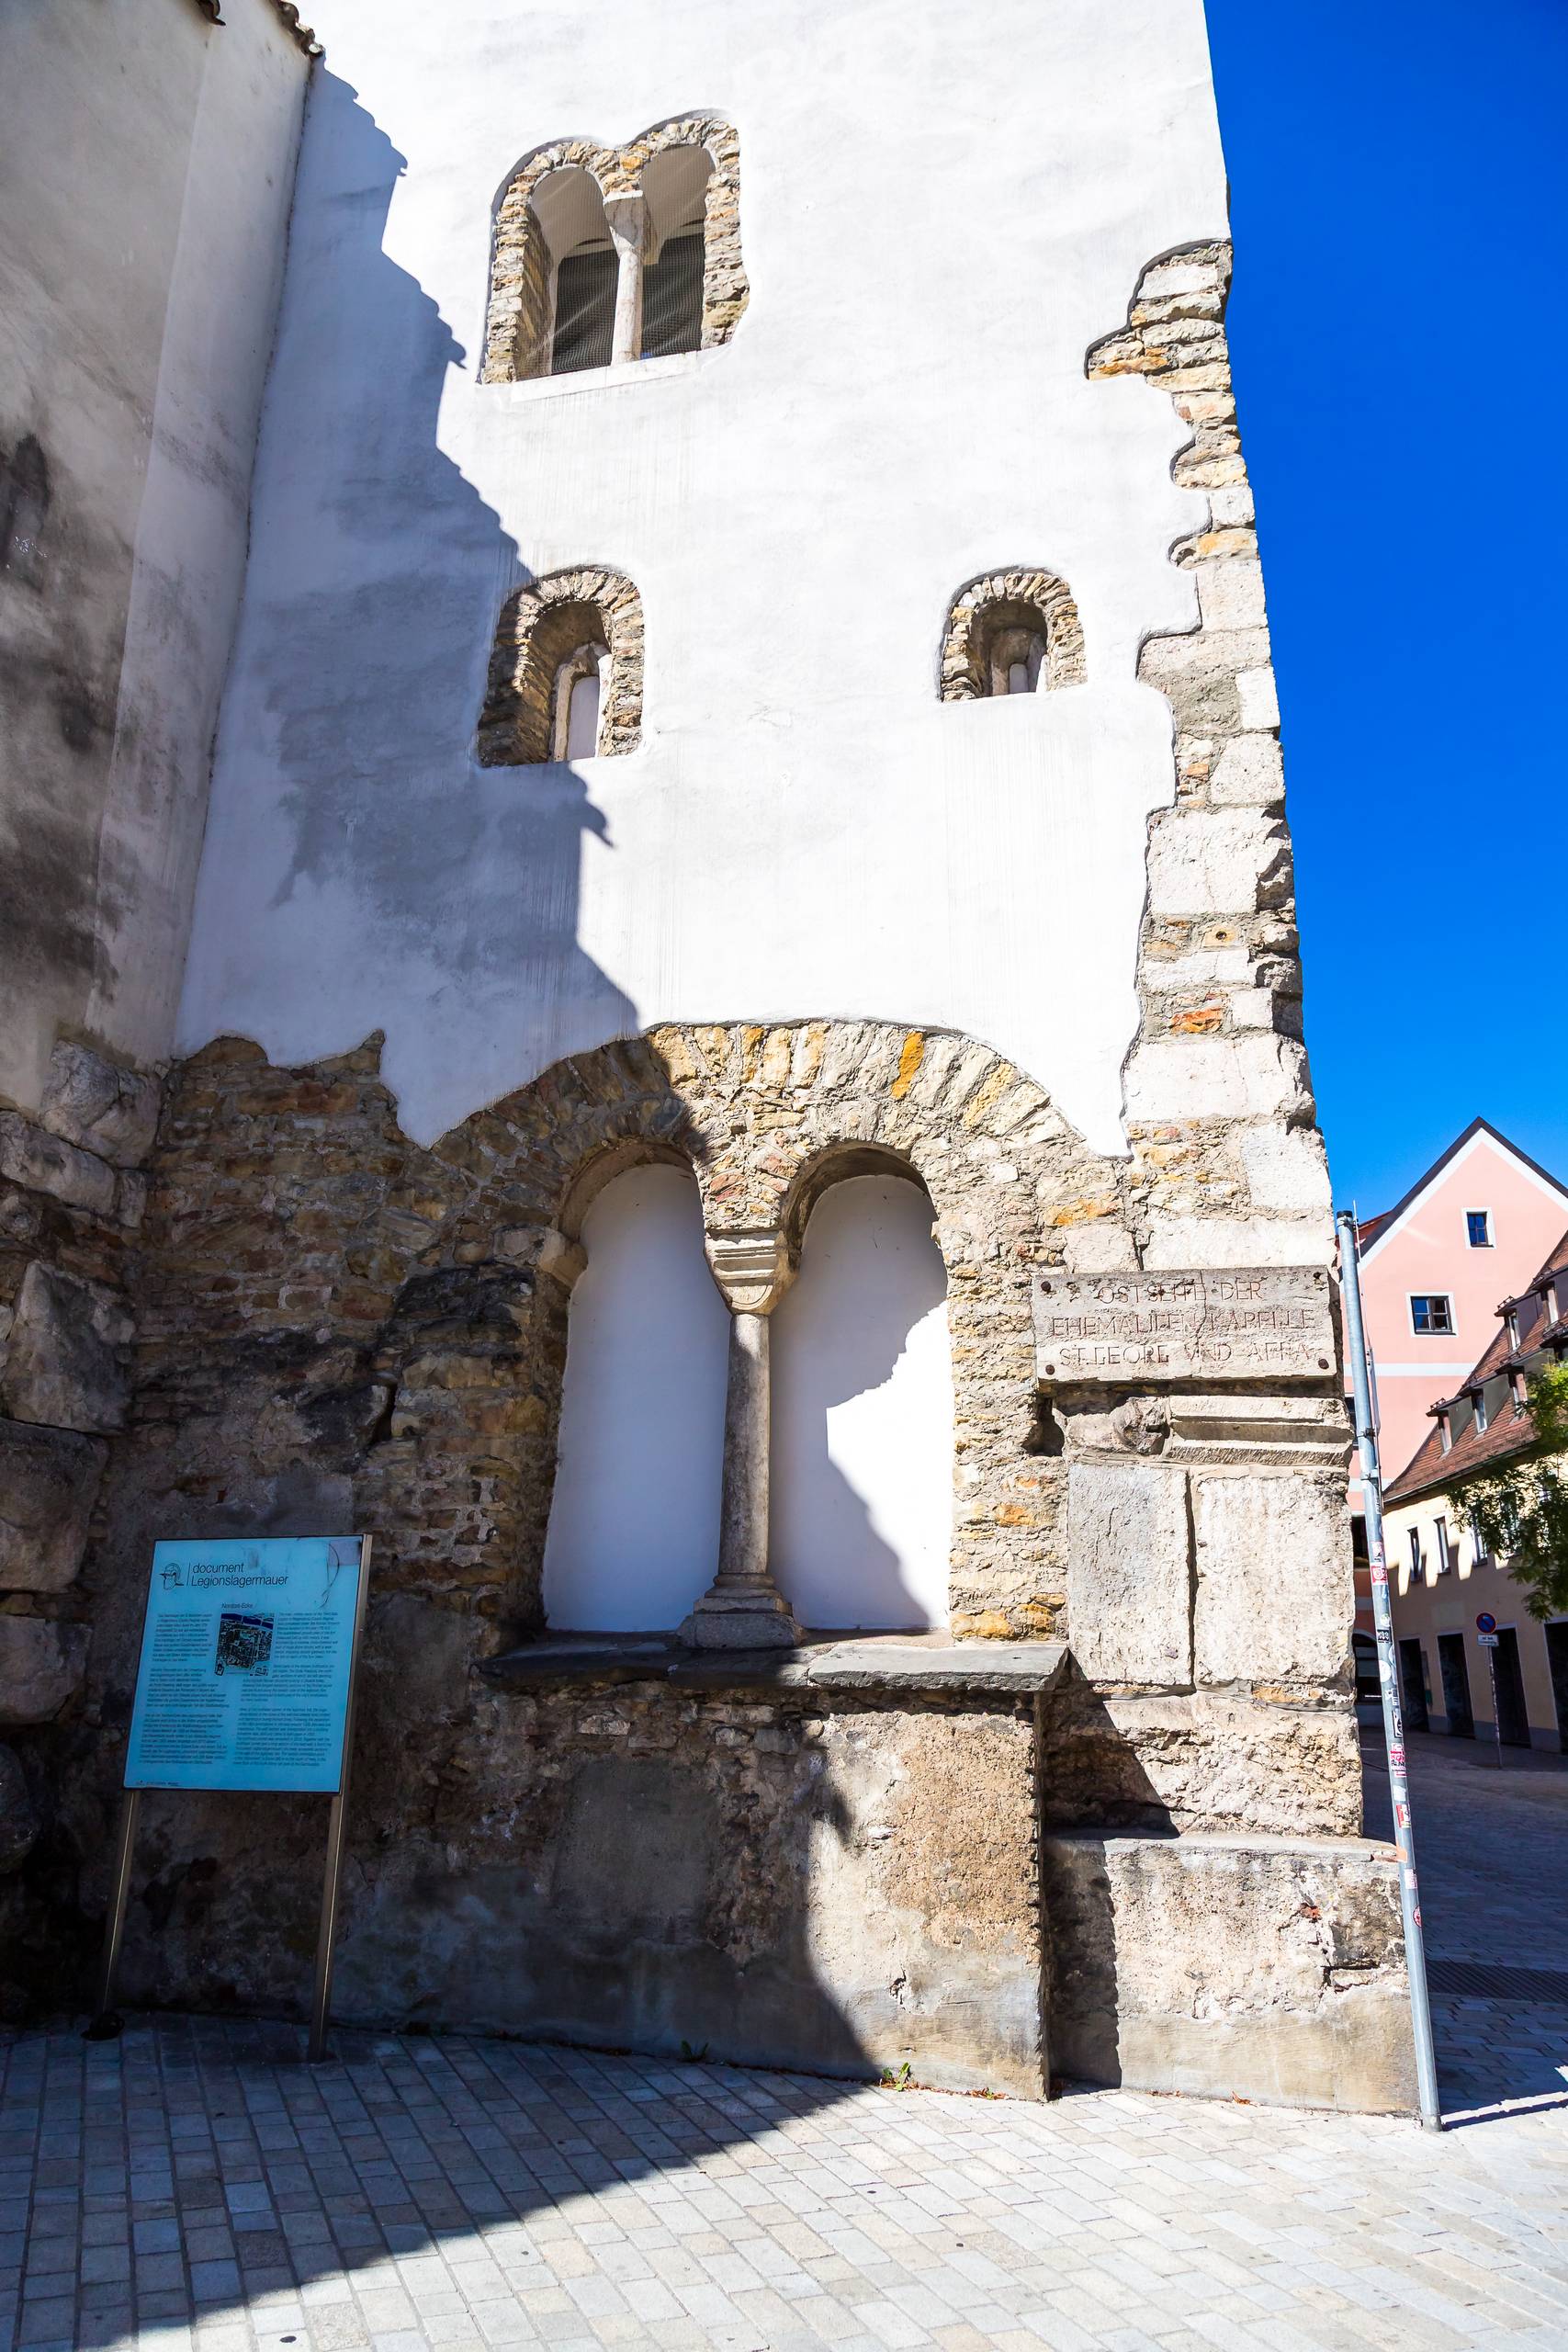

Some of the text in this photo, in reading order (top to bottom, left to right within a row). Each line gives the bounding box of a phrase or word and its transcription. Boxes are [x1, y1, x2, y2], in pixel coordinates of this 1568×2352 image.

[1099, 1280, 1263, 1304] OSTSEITE DER
[1209, 1309, 1316, 1330] KAPELLE
[192, 1563, 244, 1574] document
[191, 1575, 289, 1589] Legionslagermauer
